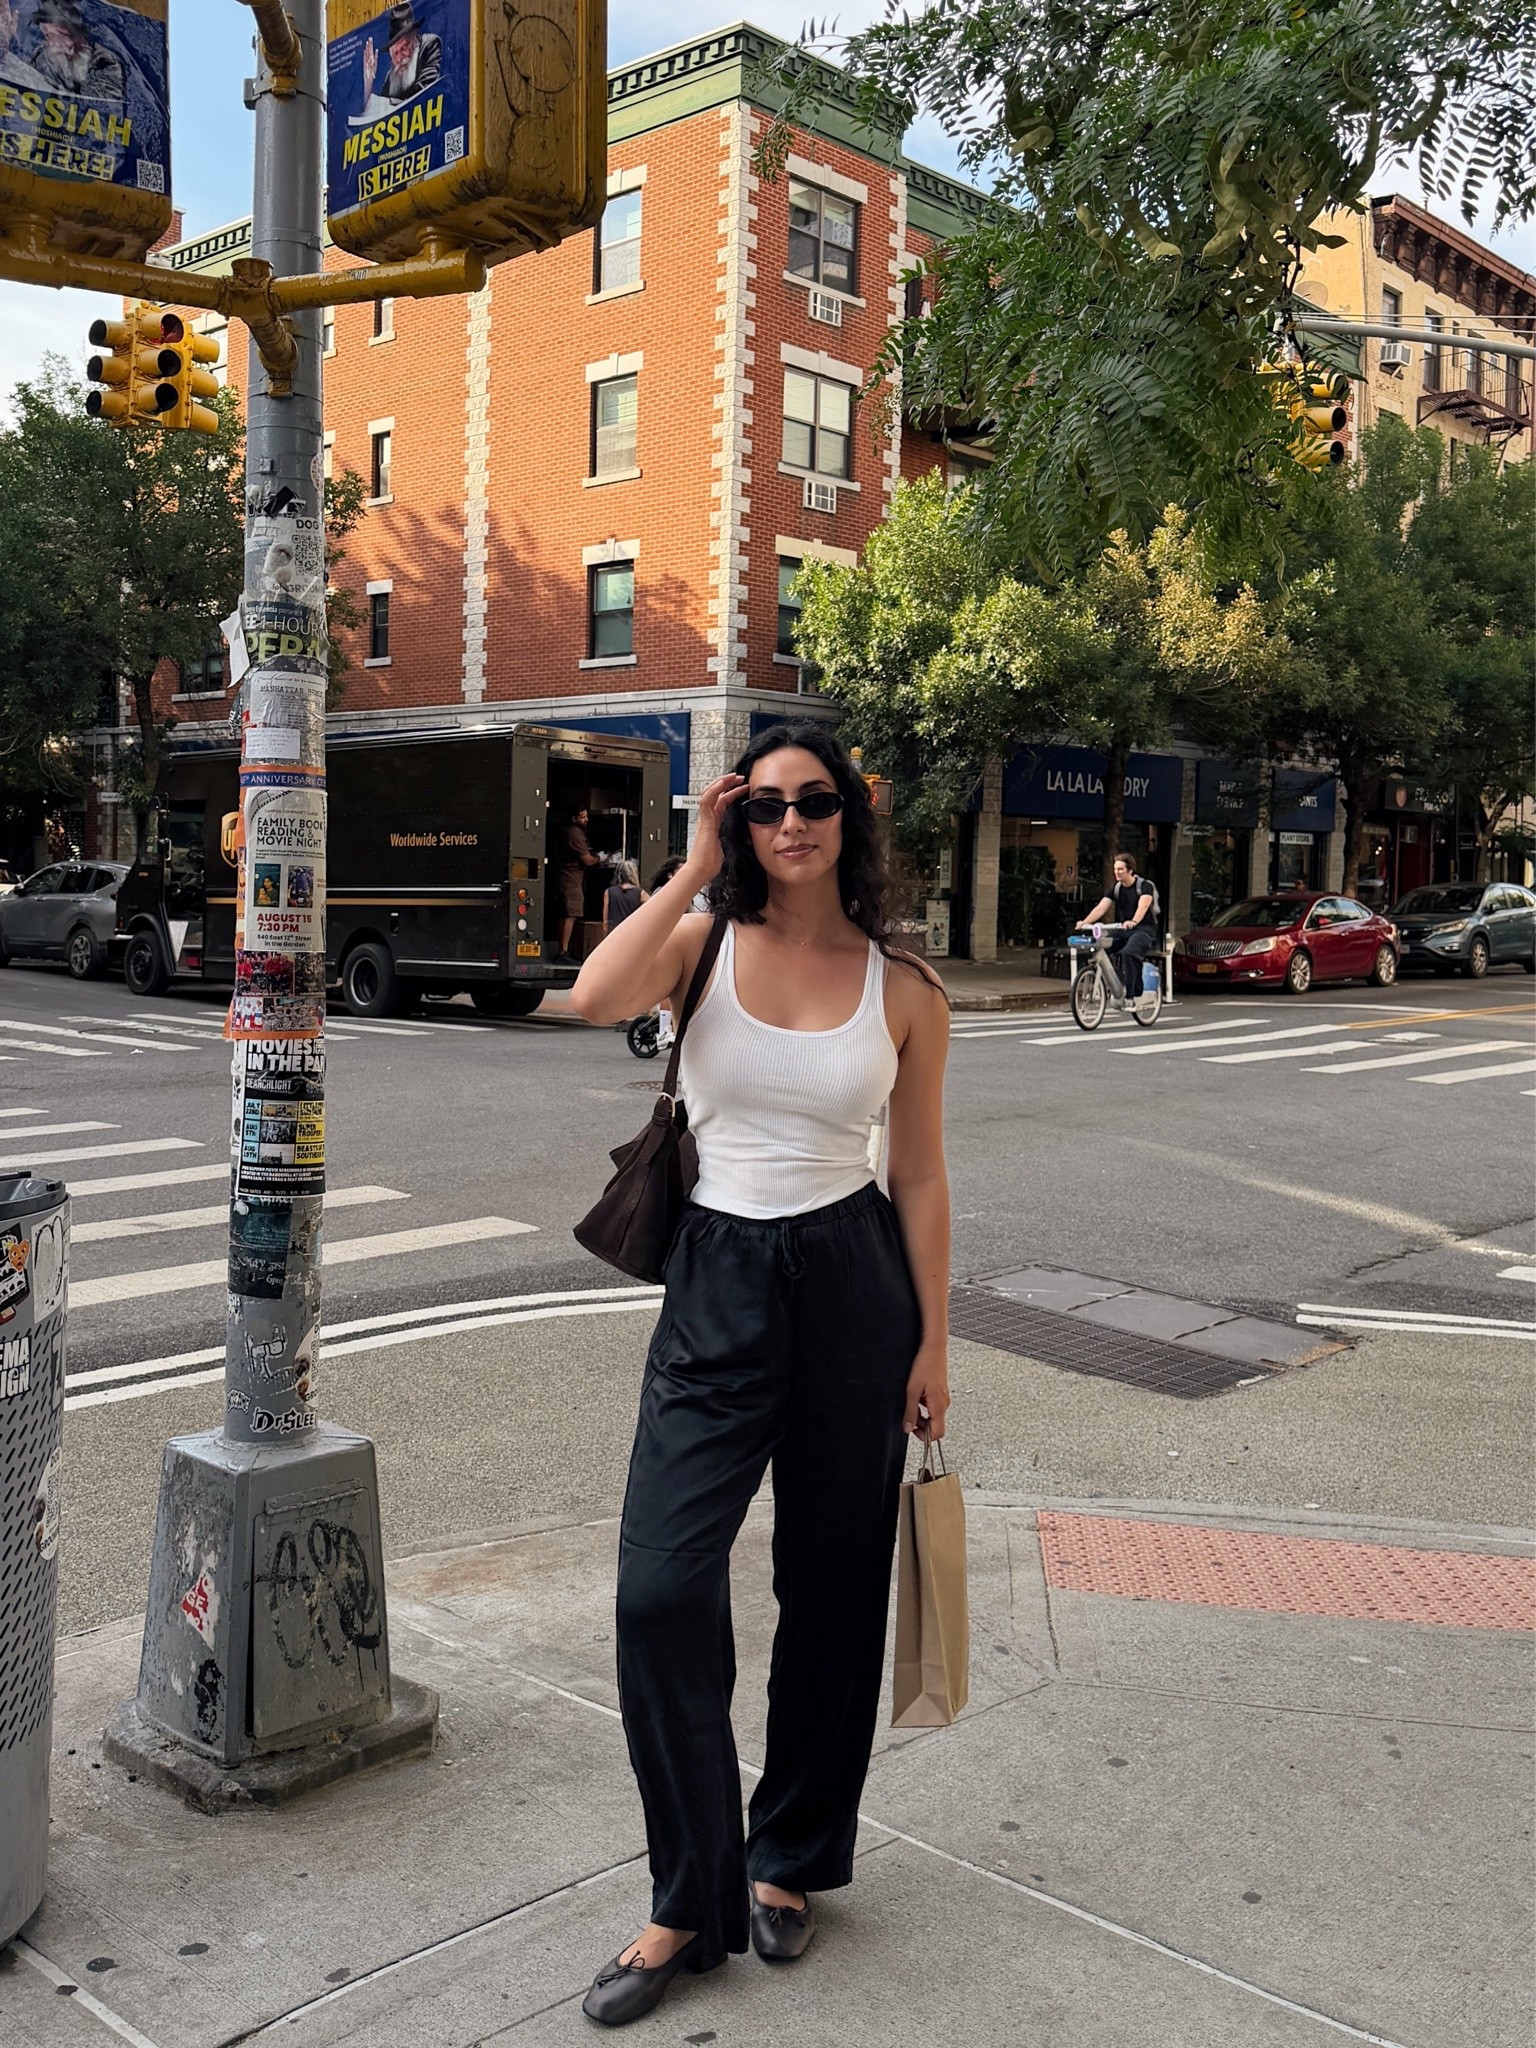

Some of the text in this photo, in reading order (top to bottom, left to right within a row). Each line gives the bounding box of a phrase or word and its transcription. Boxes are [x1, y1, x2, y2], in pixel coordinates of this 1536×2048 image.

[343, 94, 443, 171] MESSIAH
[29, 138, 111, 179] HERE!
[360, 147, 429, 199] IS HERE!
[296, 519, 319, 530] DOG
[260, 686, 304, 694] MANHATTAN
[250, 774, 316, 786] ANNIVERSARY
[1047, 769, 1065, 792] LA
[1067, 771, 1085, 793] LA
[257, 817, 323, 831] FAMILY BOOK
[257, 826, 314, 838] READING &
[256, 836, 322, 849] MOVIE NIGHT
[390, 831, 478, 847] Worldwide Services
[257, 913, 312, 924] AUGUST 15
[257, 922, 300, 933] 7:30 PM
[248, 1038, 313, 1055] MOVIES
[247, 1053, 264, 1071] IN
[266, 1054, 302, 1072] THE
[246, 1077, 292, 1090] SEARCHLIGHT
[298, 1123, 317, 1131] SUPER
